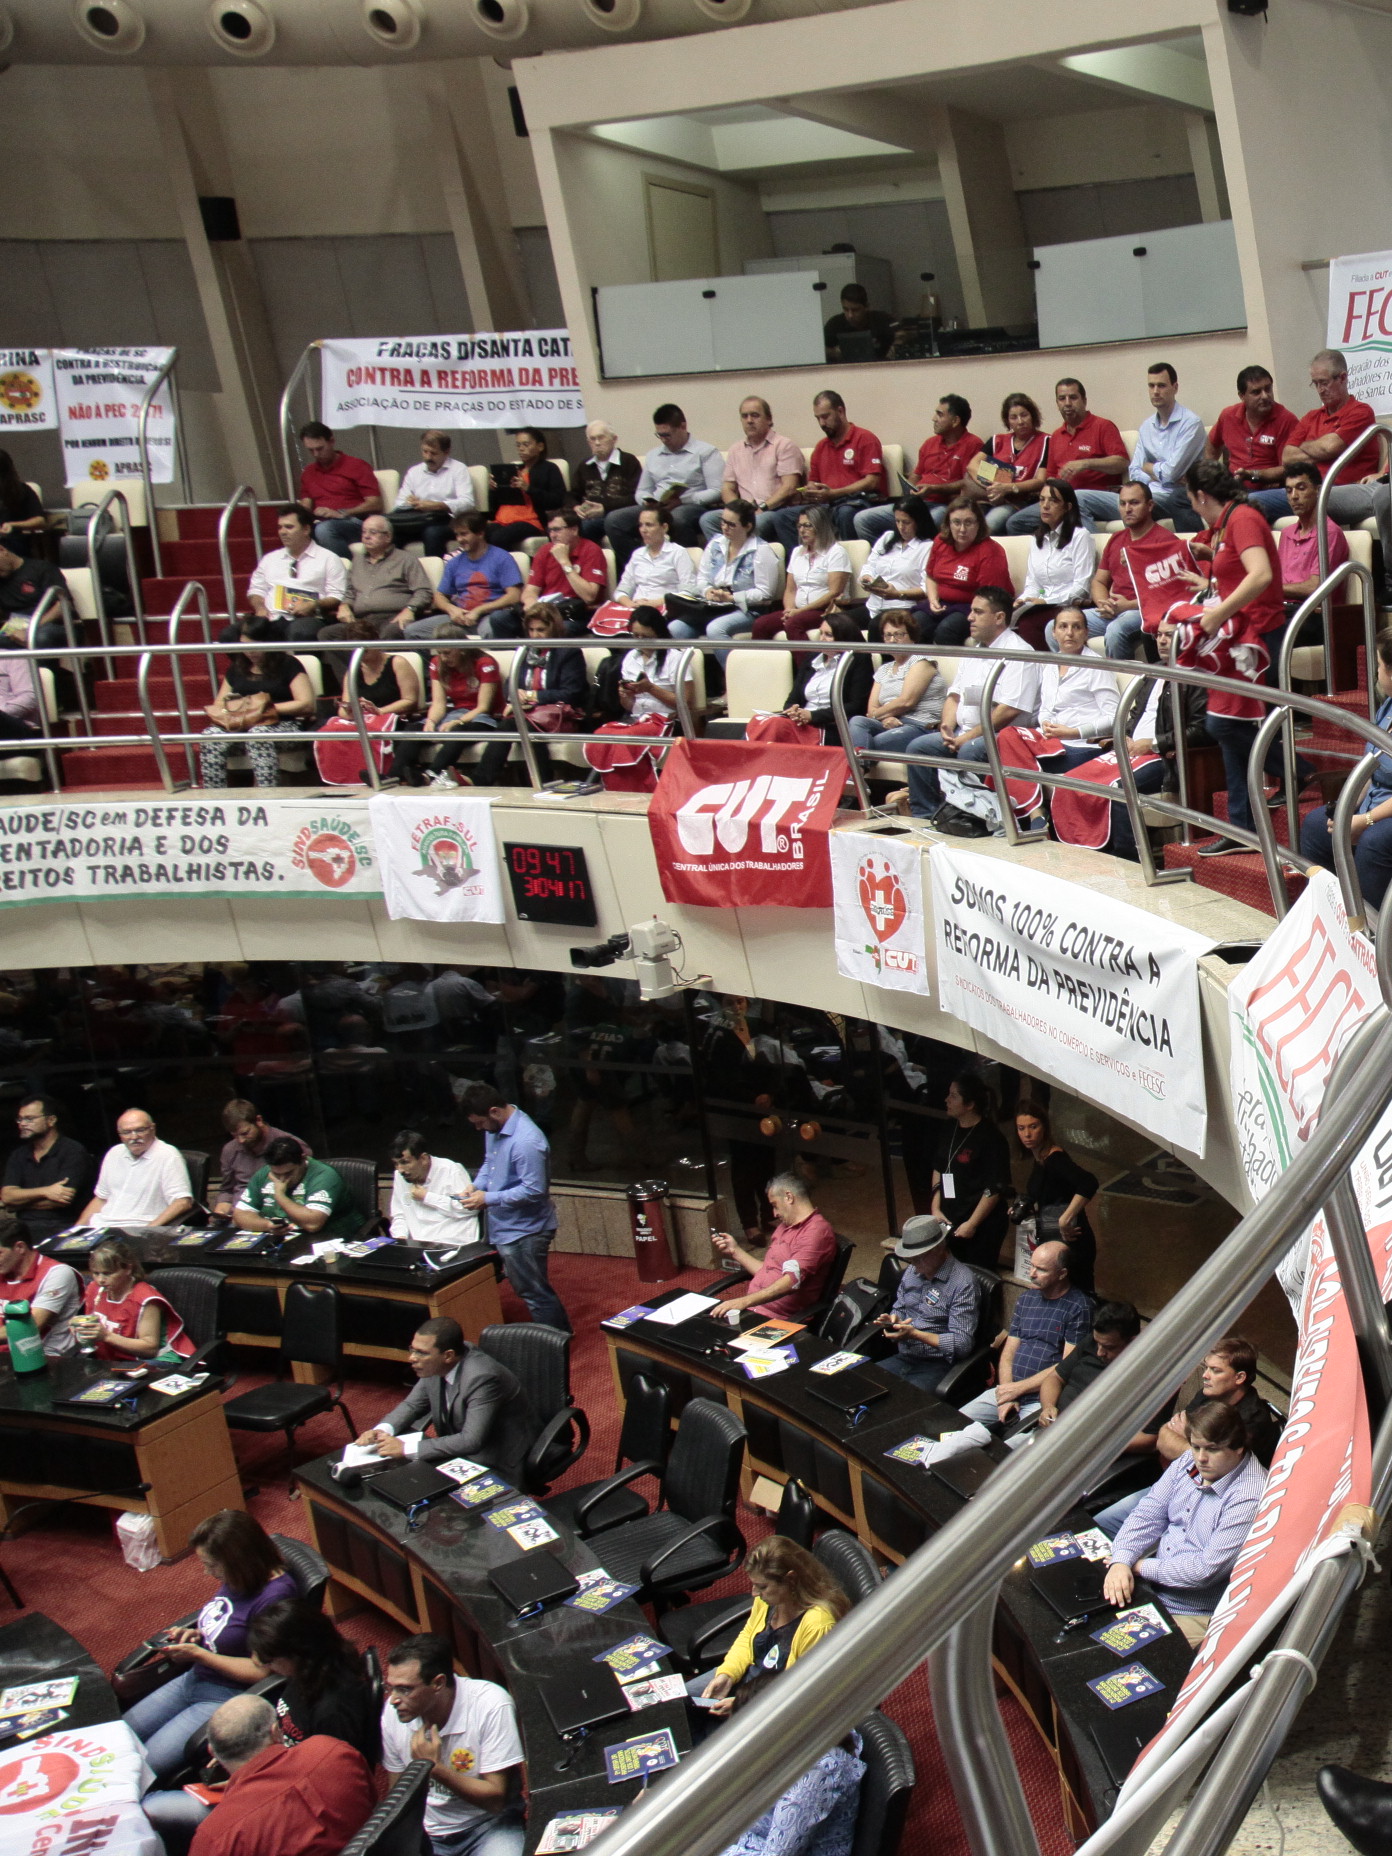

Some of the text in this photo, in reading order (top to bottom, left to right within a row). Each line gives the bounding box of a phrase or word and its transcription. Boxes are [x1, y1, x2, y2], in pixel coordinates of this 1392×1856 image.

[1374, 270, 1389, 280] CUT
[477, 338, 534, 359] SANTA
[537, 337, 573, 357] CAT
[56, 359, 91, 371] CONTRA
[94, 359, 100, 369] A
[71, 374, 84, 386] DA
[346, 366, 417, 388] CONTRA
[420, 368, 433, 388] A
[437, 367, 515, 389] REFORMA
[519, 368, 542, 387] DA
[68, 402, 93, 421] NÃO
[104, 403, 127, 419] PEC
[336, 397, 410, 413] ASSOCIAÇÃO
[413, 400, 431, 411] DE
[435, 401, 484, 413] PRAÇAS
[487, 400, 506, 410] DO
[509, 399, 555, 410] ESTADO
[558, 399, 574, 410] DE
[1144, 553, 1182, 584] CUT
[100, 810, 128, 826] em
[134, 807, 226, 828] DEFESA
[236, 806, 269, 827] DA
[676, 775, 814, 856] CUT
[790, 769, 830, 859] BRASIL
[154, 835, 168, 855] E
[180, 834, 231, 855] DOS
[0, 861, 285, 891] EITOS TRABALHISTAS.
[708, 861, 730, 871] ÚNICA
[730, 861, 745, 870] DOS
[746, 861, 804, 871] TRABALHADORES
[951, 875, 1007, 924] SOMOS
[1010, 901, 1058, 948] 100%
[1060, 921, 1143, 980] CONTRA
[1148, 951, 1161, 989] A
[885, 949, 918, 971] CUT
[943, 918, 1174, 1058] REFORMA DA PREVIDÊNCIA
[954, 974, 985, 1001] SINDICATOS
[996, 997, 1048, 1035] TRABALHADORES
[1048, 1023, 1059, 1040] NO
[1059, 1029, 1089, 1058] COMÉRCIO
[1089, 1047, 1096, 1062] E
[1095, 1049, 1131, 1080] SERVIÇOS
[1131, 1070, 1138, 1081] e
[1138, 1069, 1167, 1097] FECESC
